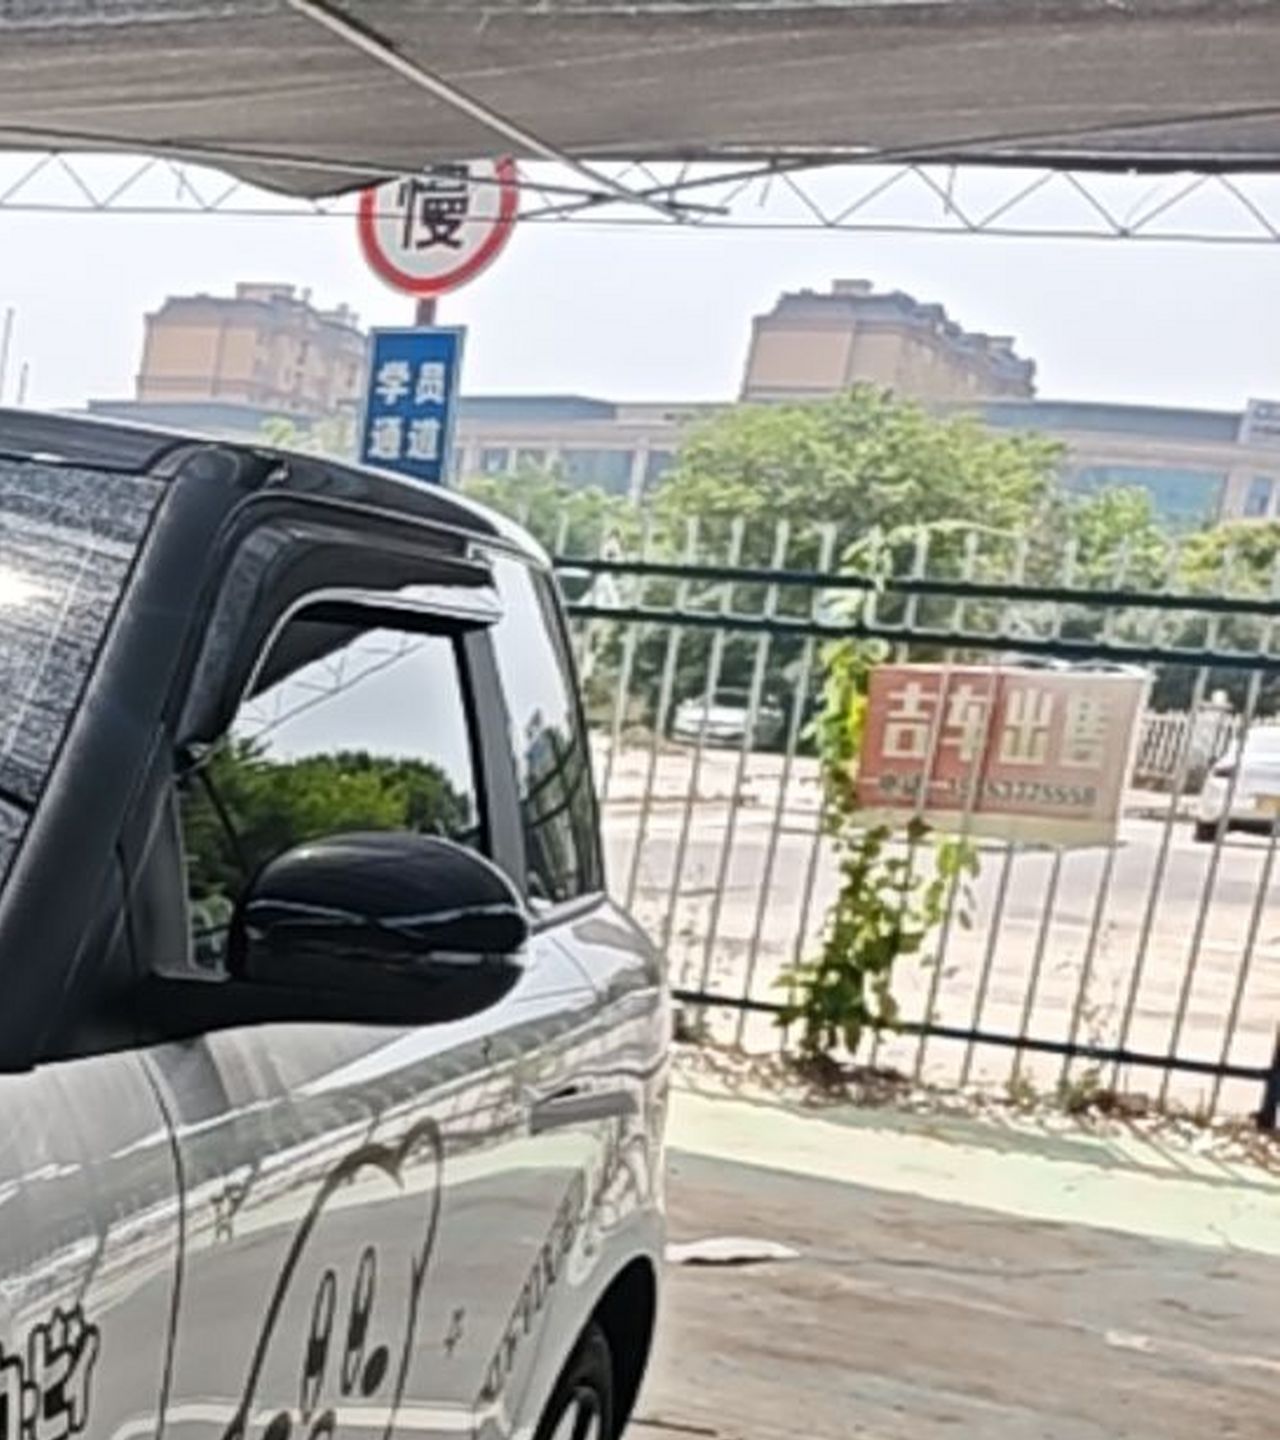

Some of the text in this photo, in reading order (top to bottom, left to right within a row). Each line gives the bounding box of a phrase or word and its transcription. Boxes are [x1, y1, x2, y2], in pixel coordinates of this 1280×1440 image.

[397, 164, 469, 250] 慢
[375, 361, 445, 405] 学员
[367, 416, 440, 460] 通道
